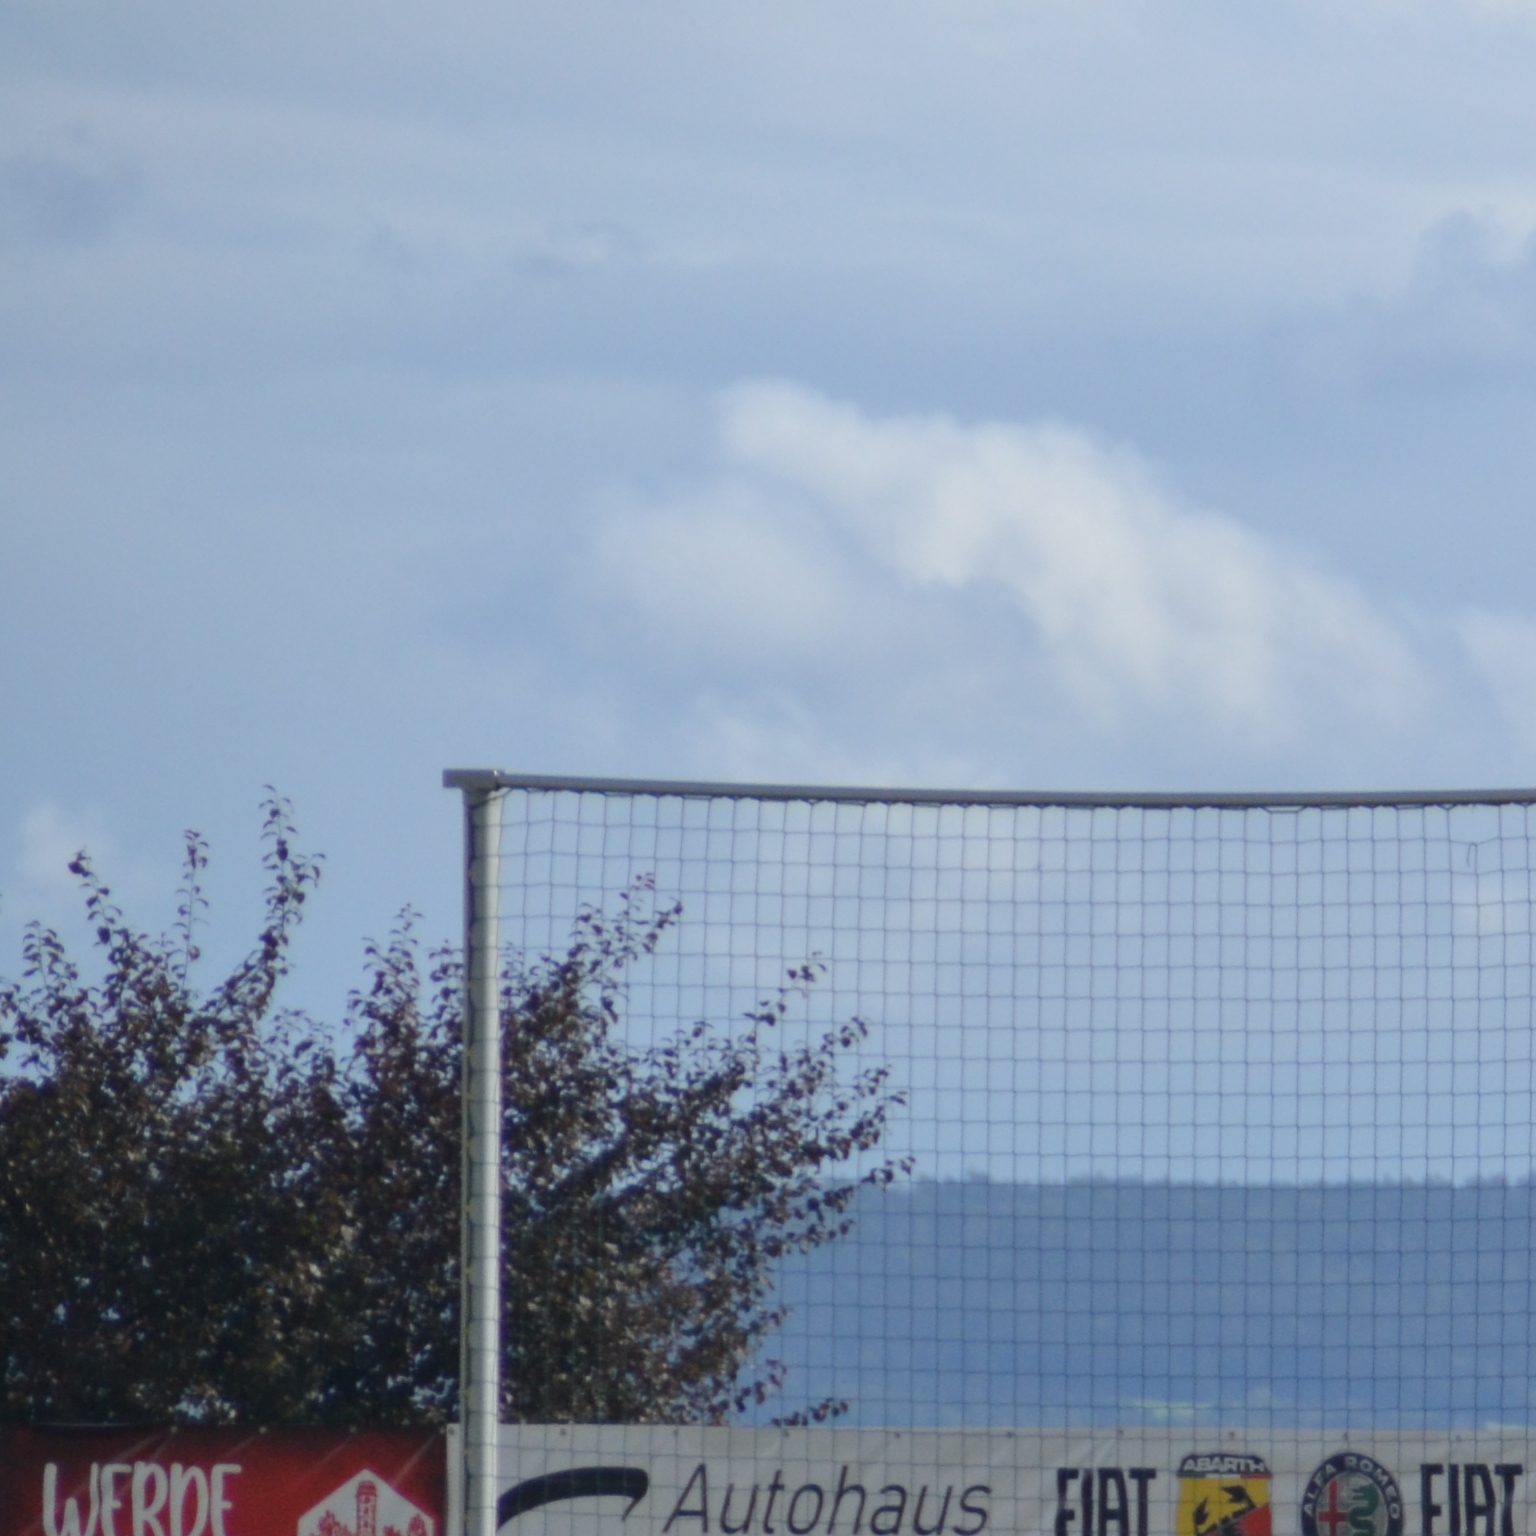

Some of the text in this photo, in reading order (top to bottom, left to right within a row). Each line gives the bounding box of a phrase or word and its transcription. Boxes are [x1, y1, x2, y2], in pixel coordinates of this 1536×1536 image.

[1183, 1455, 1266, 1473] ABARTH
[1303, 1455, 1400, 1520] ALFA ROMEO
[662, 1463, 992, 1536] Autohaus
